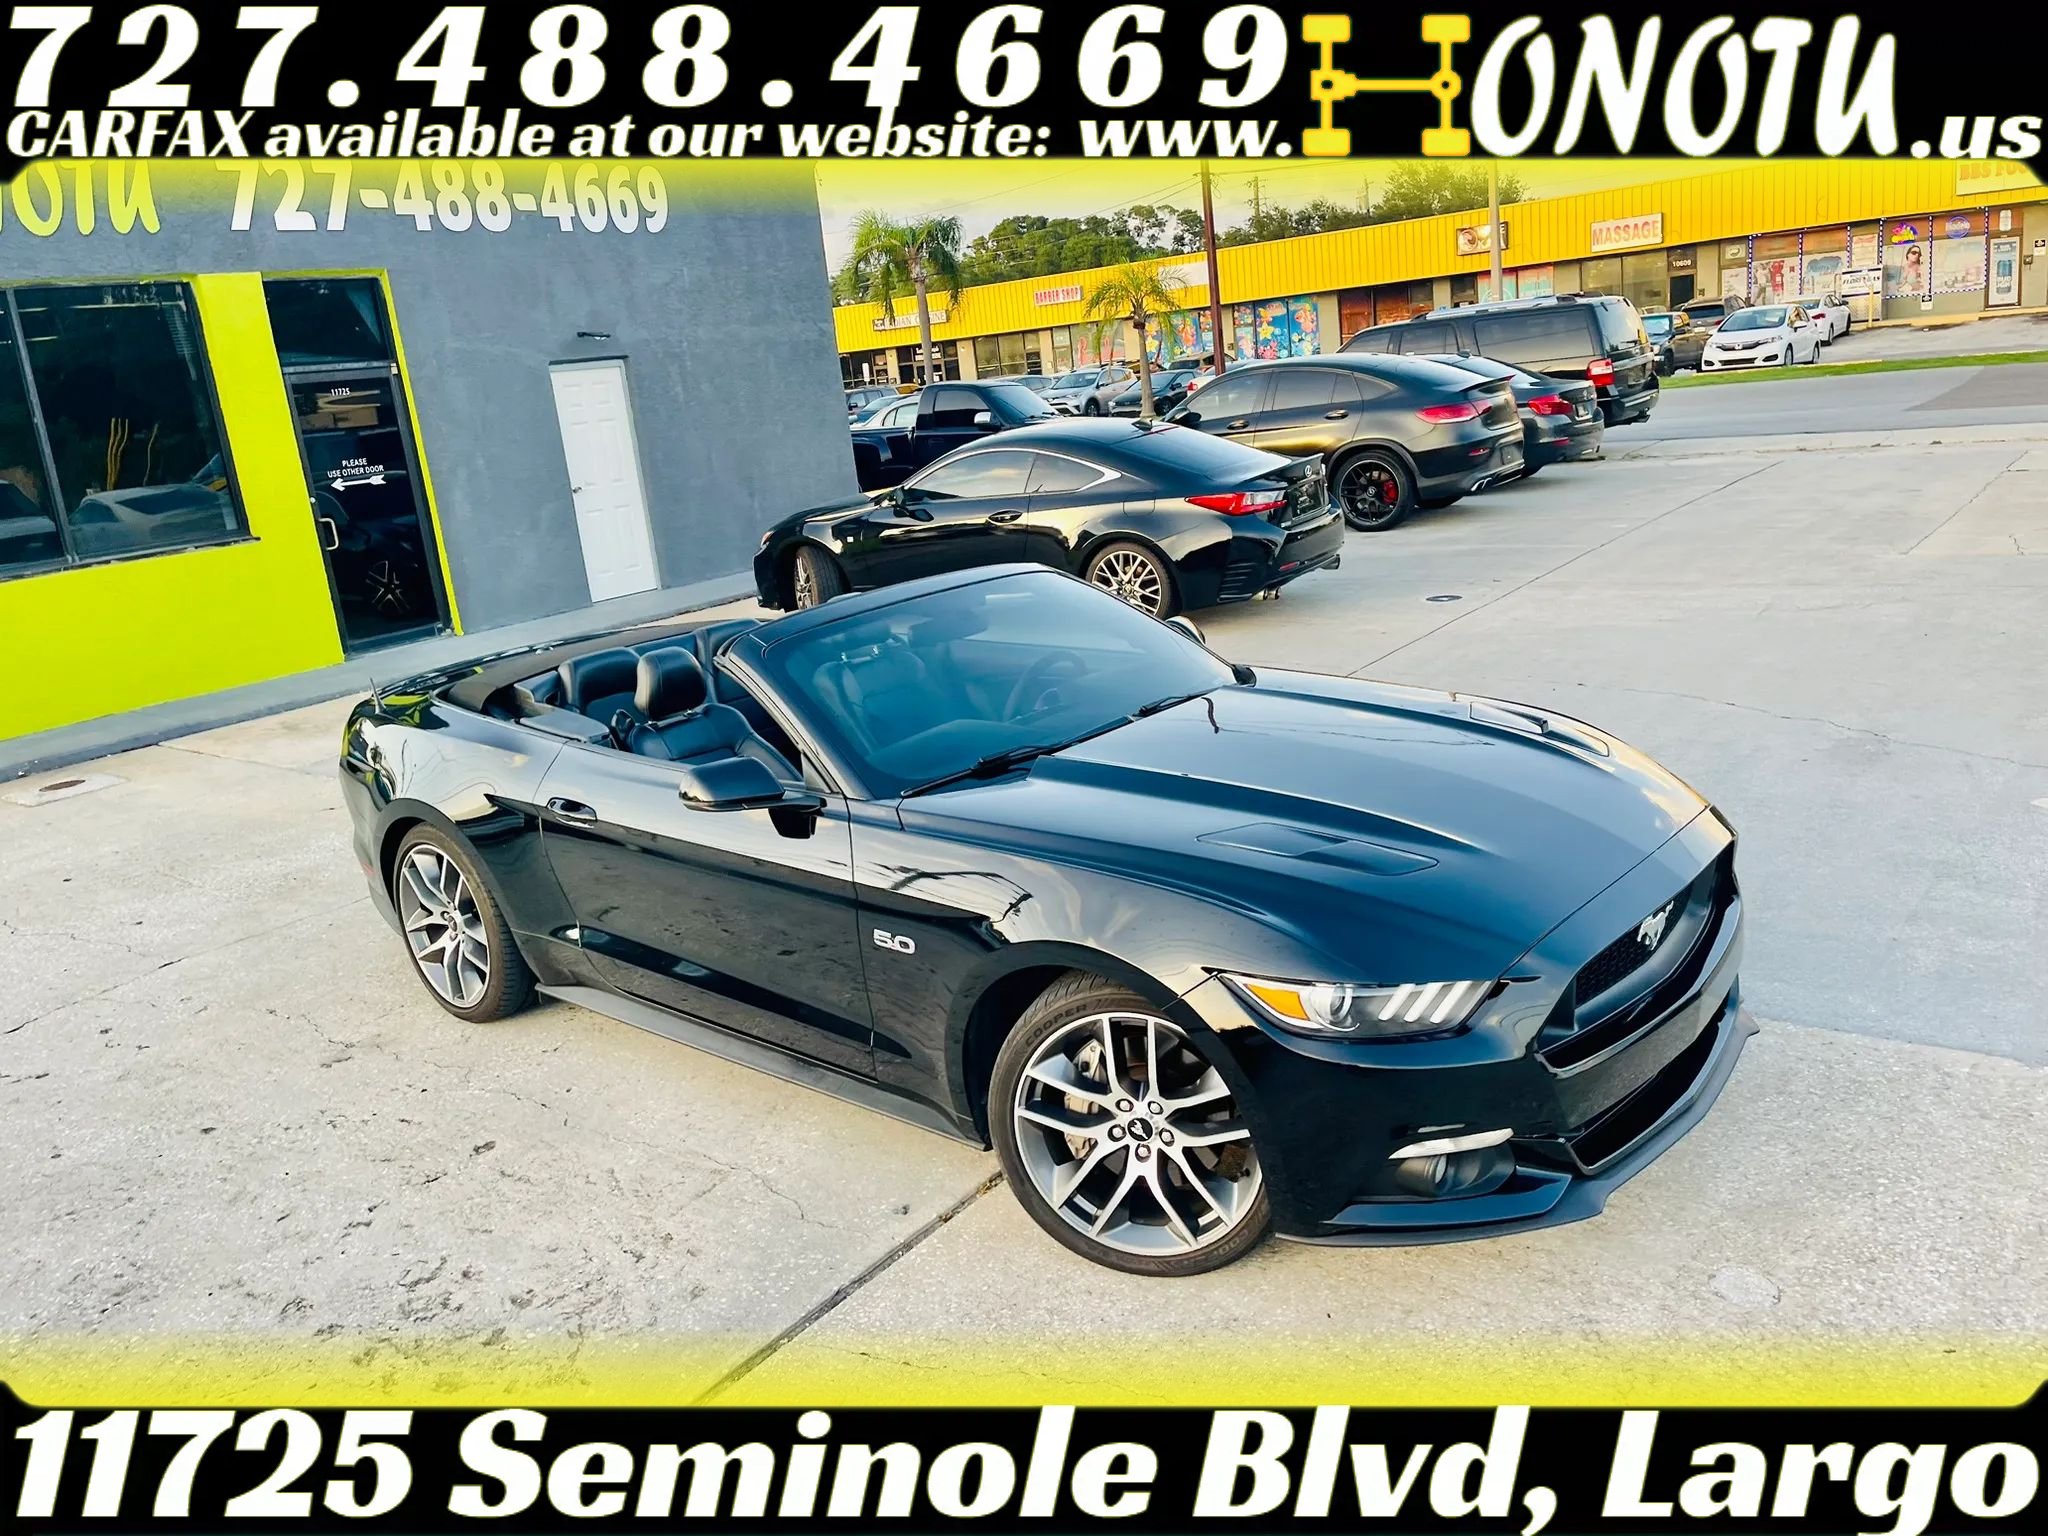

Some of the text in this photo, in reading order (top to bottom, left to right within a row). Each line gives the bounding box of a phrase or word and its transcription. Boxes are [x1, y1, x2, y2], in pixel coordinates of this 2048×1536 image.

[215, 160, 669, 233] 727-488-4669
[1592, 220, 1660, 246] MASSAGE
[1035, 287, 1078, 305] BARBER SHOP
[331, 387, 351, 396] 11725
[327, 464, 385, 478] USE OTHER DOOR
[341, 457, 368, 468] PLEASE
[1025, 1003, 1088, 1047] COOPER
